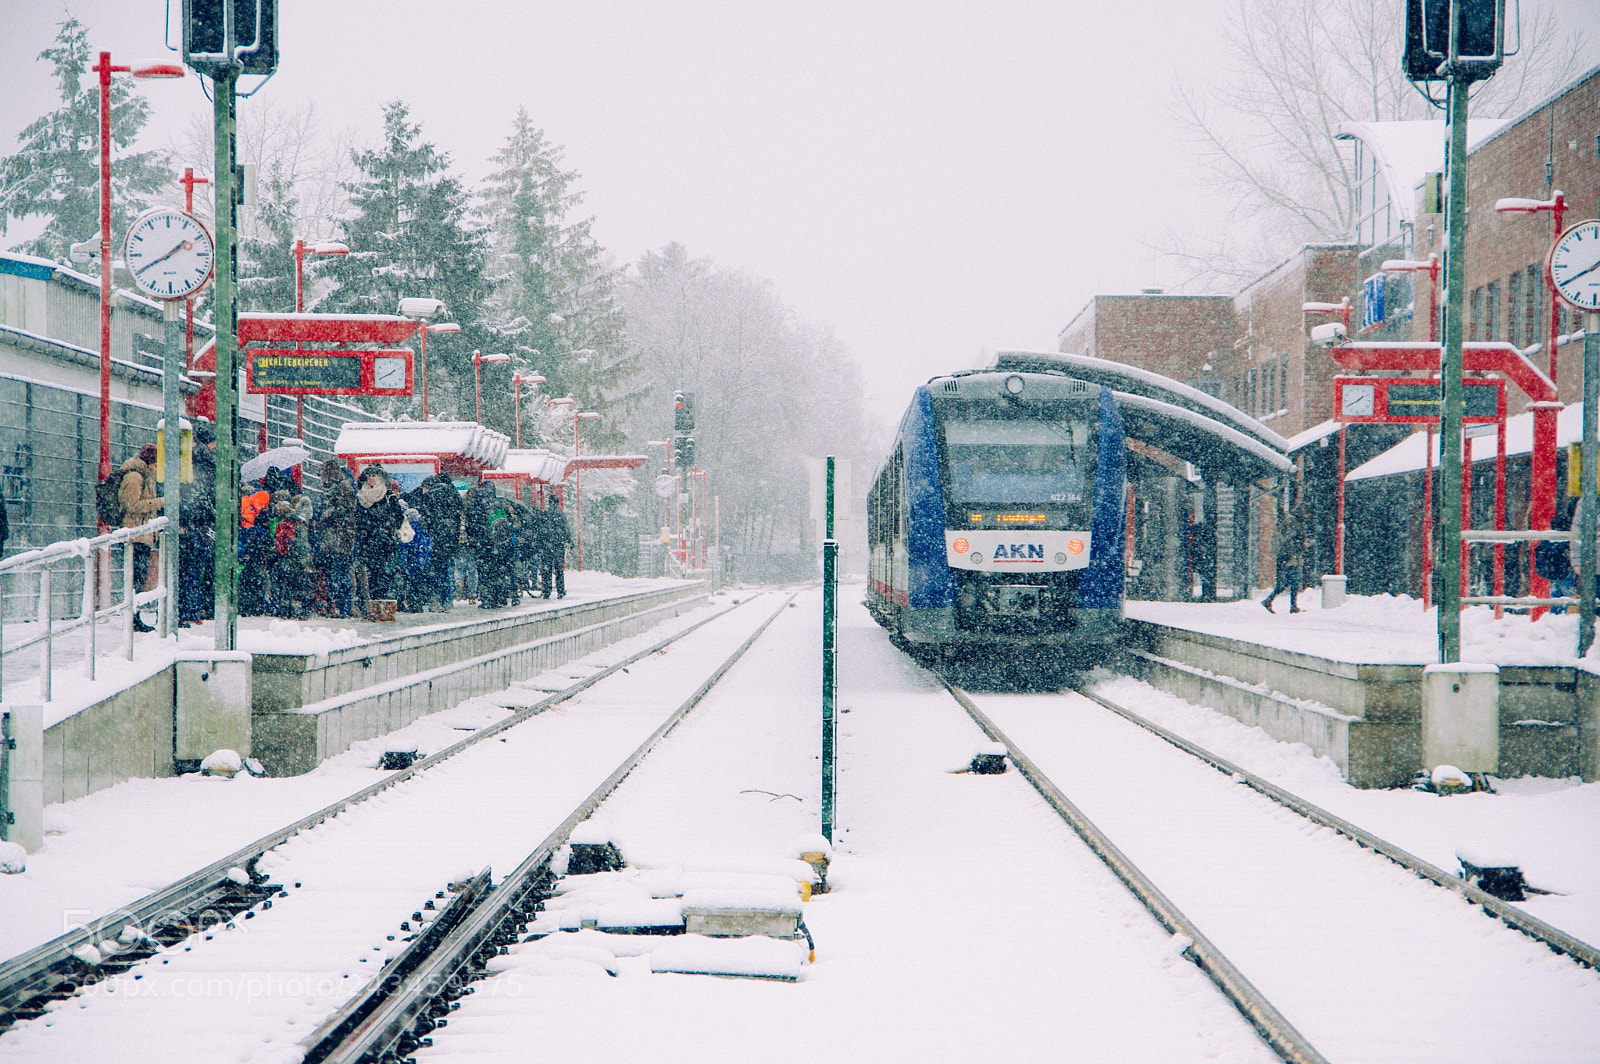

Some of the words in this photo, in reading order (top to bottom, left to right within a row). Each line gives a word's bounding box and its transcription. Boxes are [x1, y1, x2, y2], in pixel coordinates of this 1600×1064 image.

[268, 357, 328, 366] KALTENKIRCHEN
[1051, 493, 1066, 502] 622
[994, 544, 1044, 559] AKN
